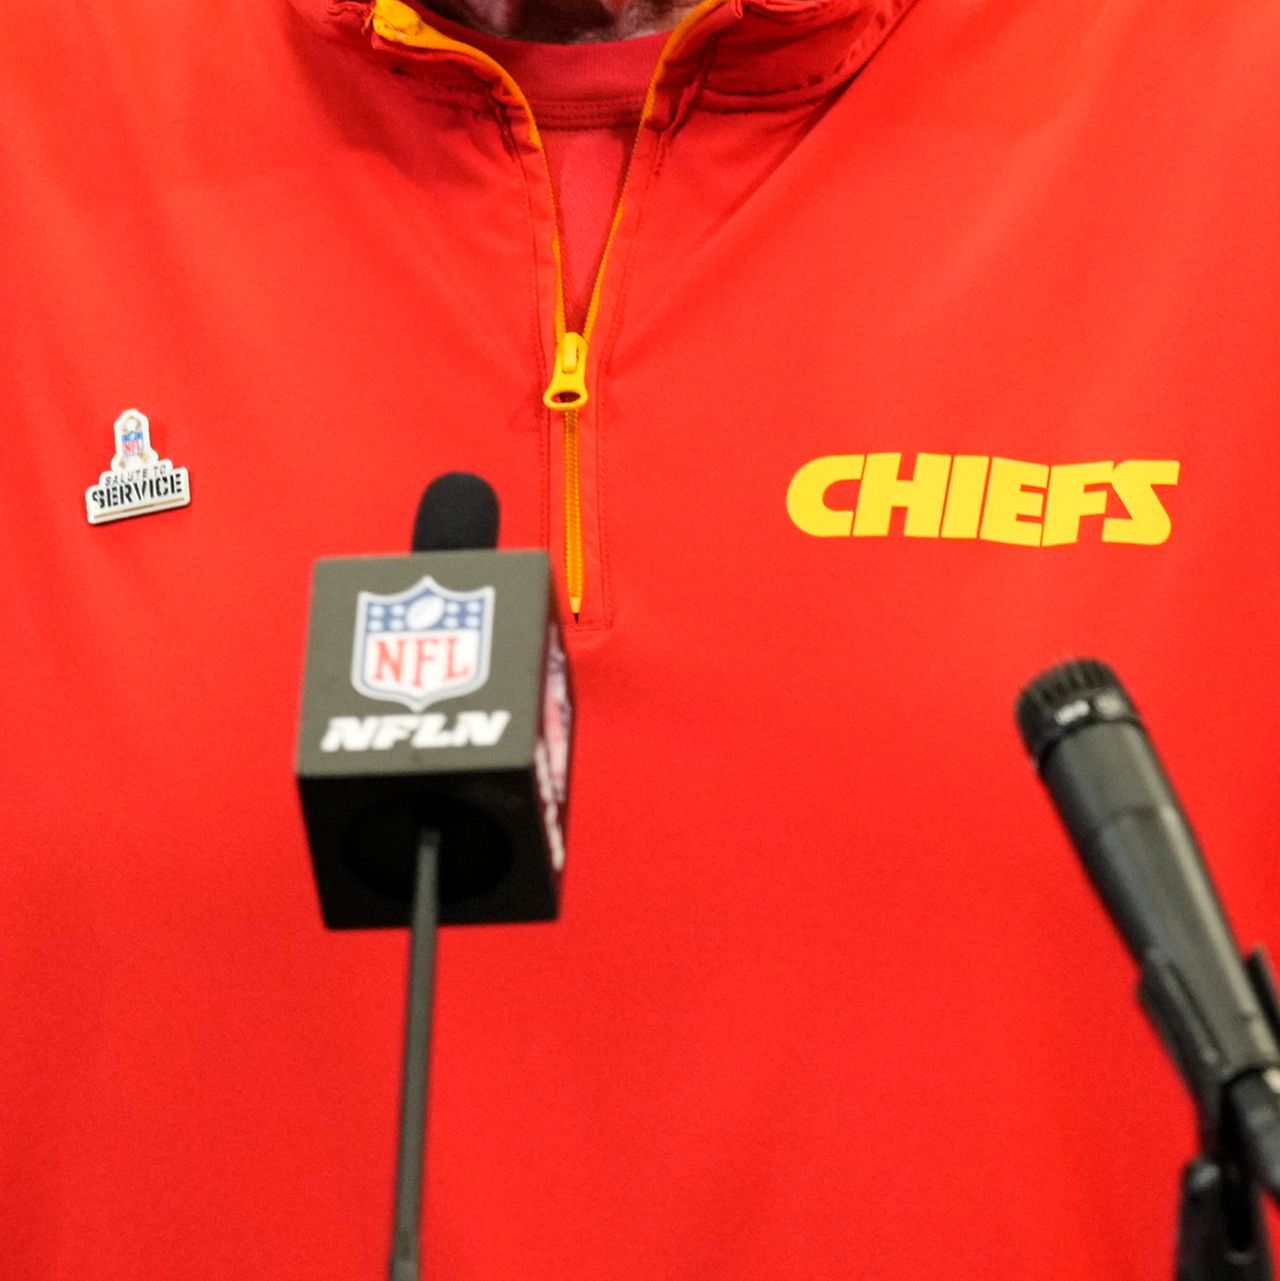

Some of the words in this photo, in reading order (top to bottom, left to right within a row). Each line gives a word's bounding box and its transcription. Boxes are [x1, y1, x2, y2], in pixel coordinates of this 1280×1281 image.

[91, 472, 183, 509] SERVICE
[105, 468, 148, 487] SALUTE
[153, 464, 167, 476] TO
[785, 452, 1181, 548] CHIEFS
[372, 635, 472, 689] NFL
[320, 709, 511, 753] NFLN
